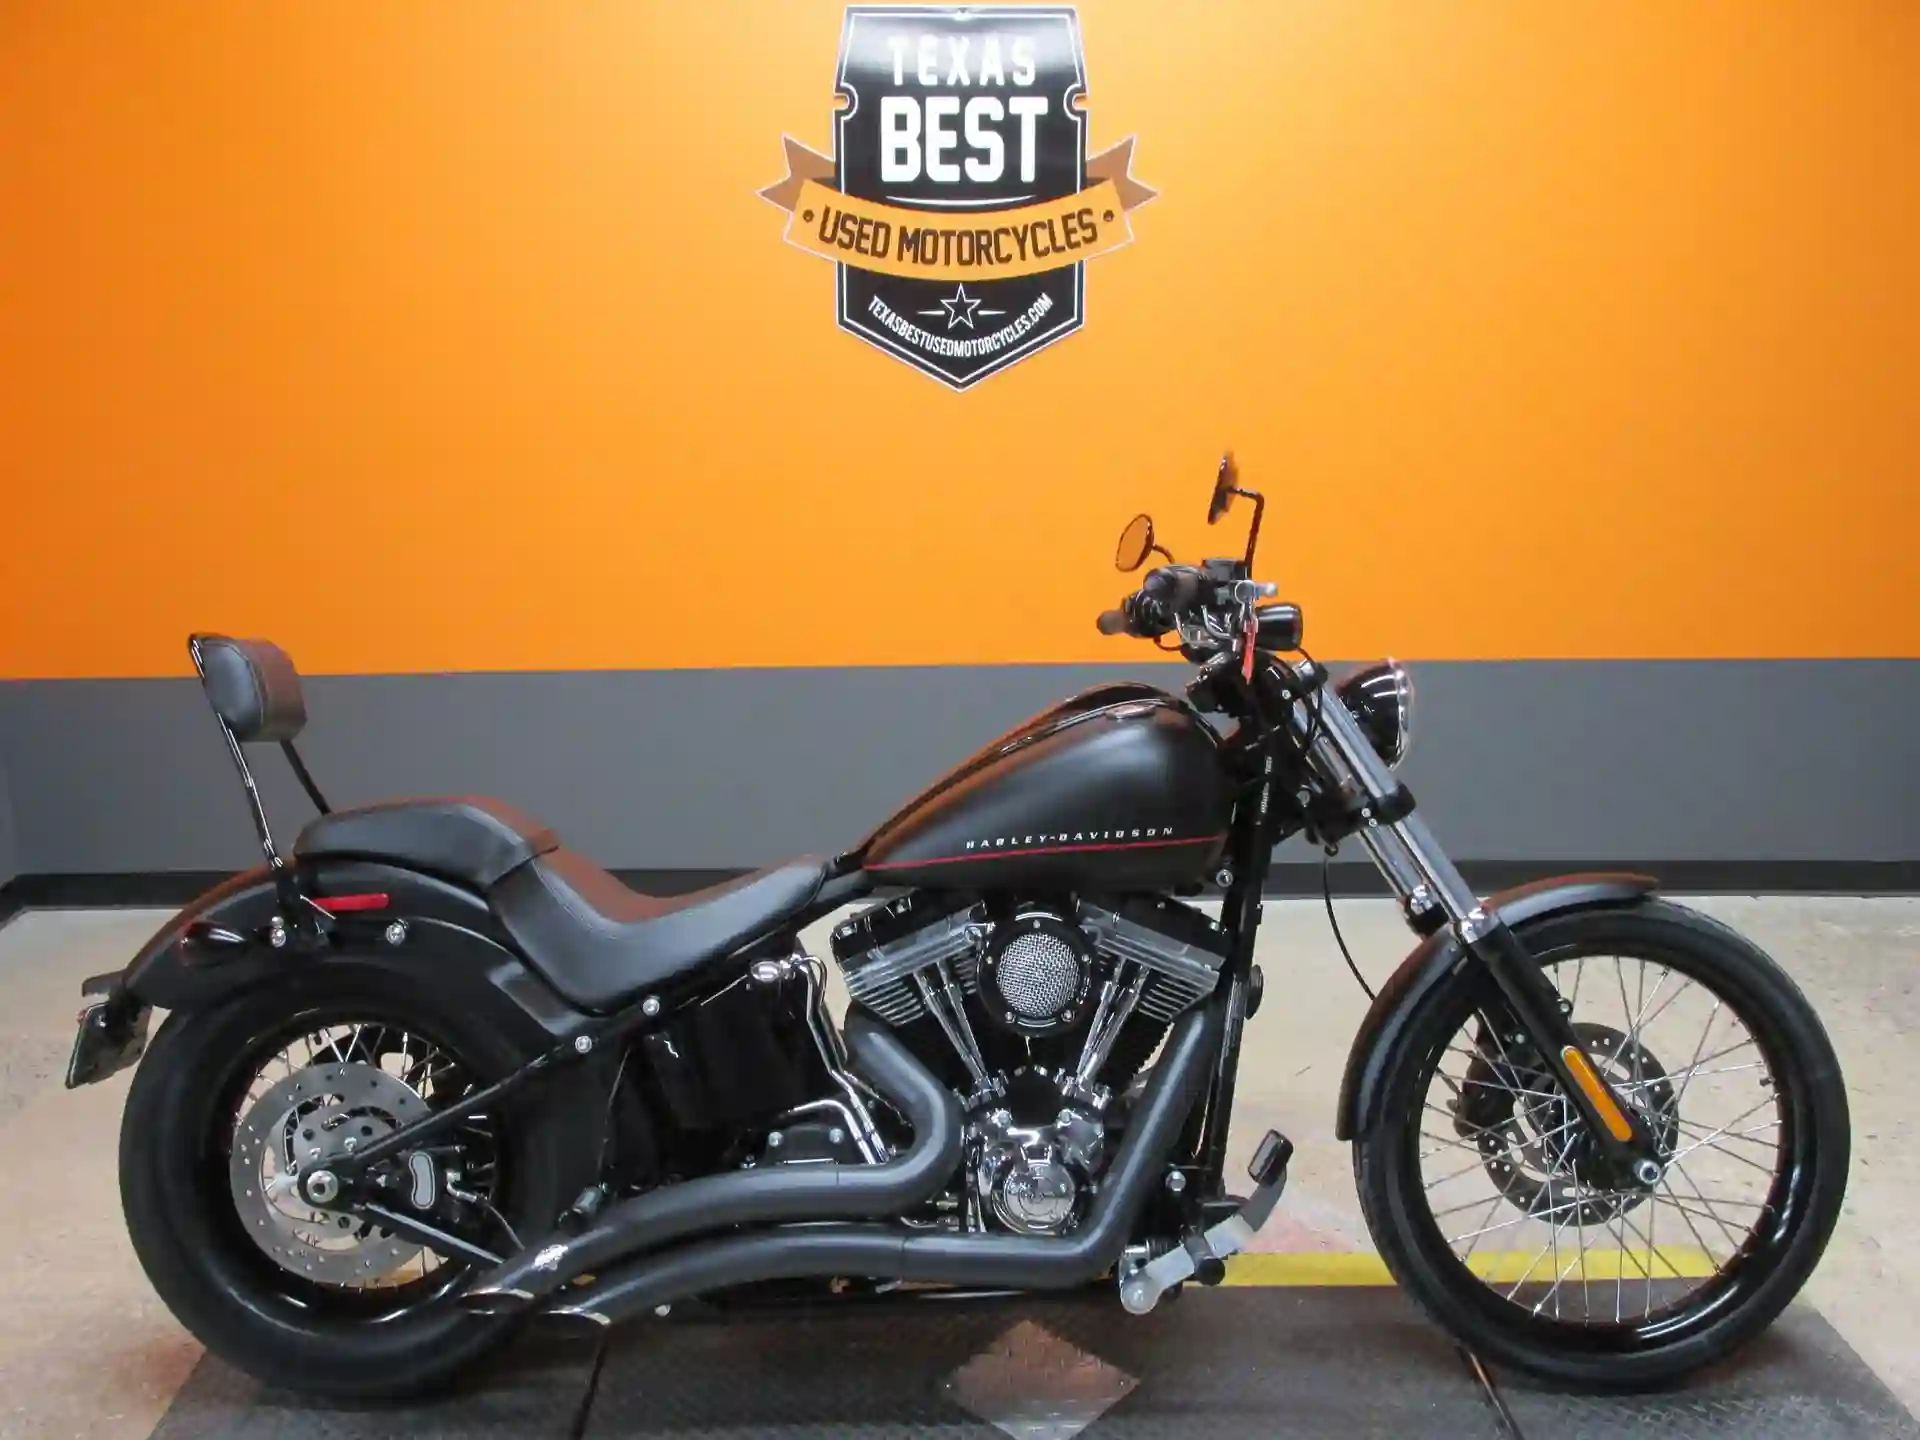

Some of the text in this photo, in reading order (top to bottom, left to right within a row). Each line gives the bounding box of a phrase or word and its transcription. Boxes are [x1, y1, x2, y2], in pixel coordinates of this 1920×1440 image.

[886, 35, 1036, 87] TEXAS
[880, 96, 1048, 183] BEST
[818, 205, 1098, 267] USED MOTORCYCLES
[867, 292, 1054, 357] TEXASBESTUSEDMOTORCYCLES.COM
[965, 827, 1174, 849] HARLEY-DAVIDSON
